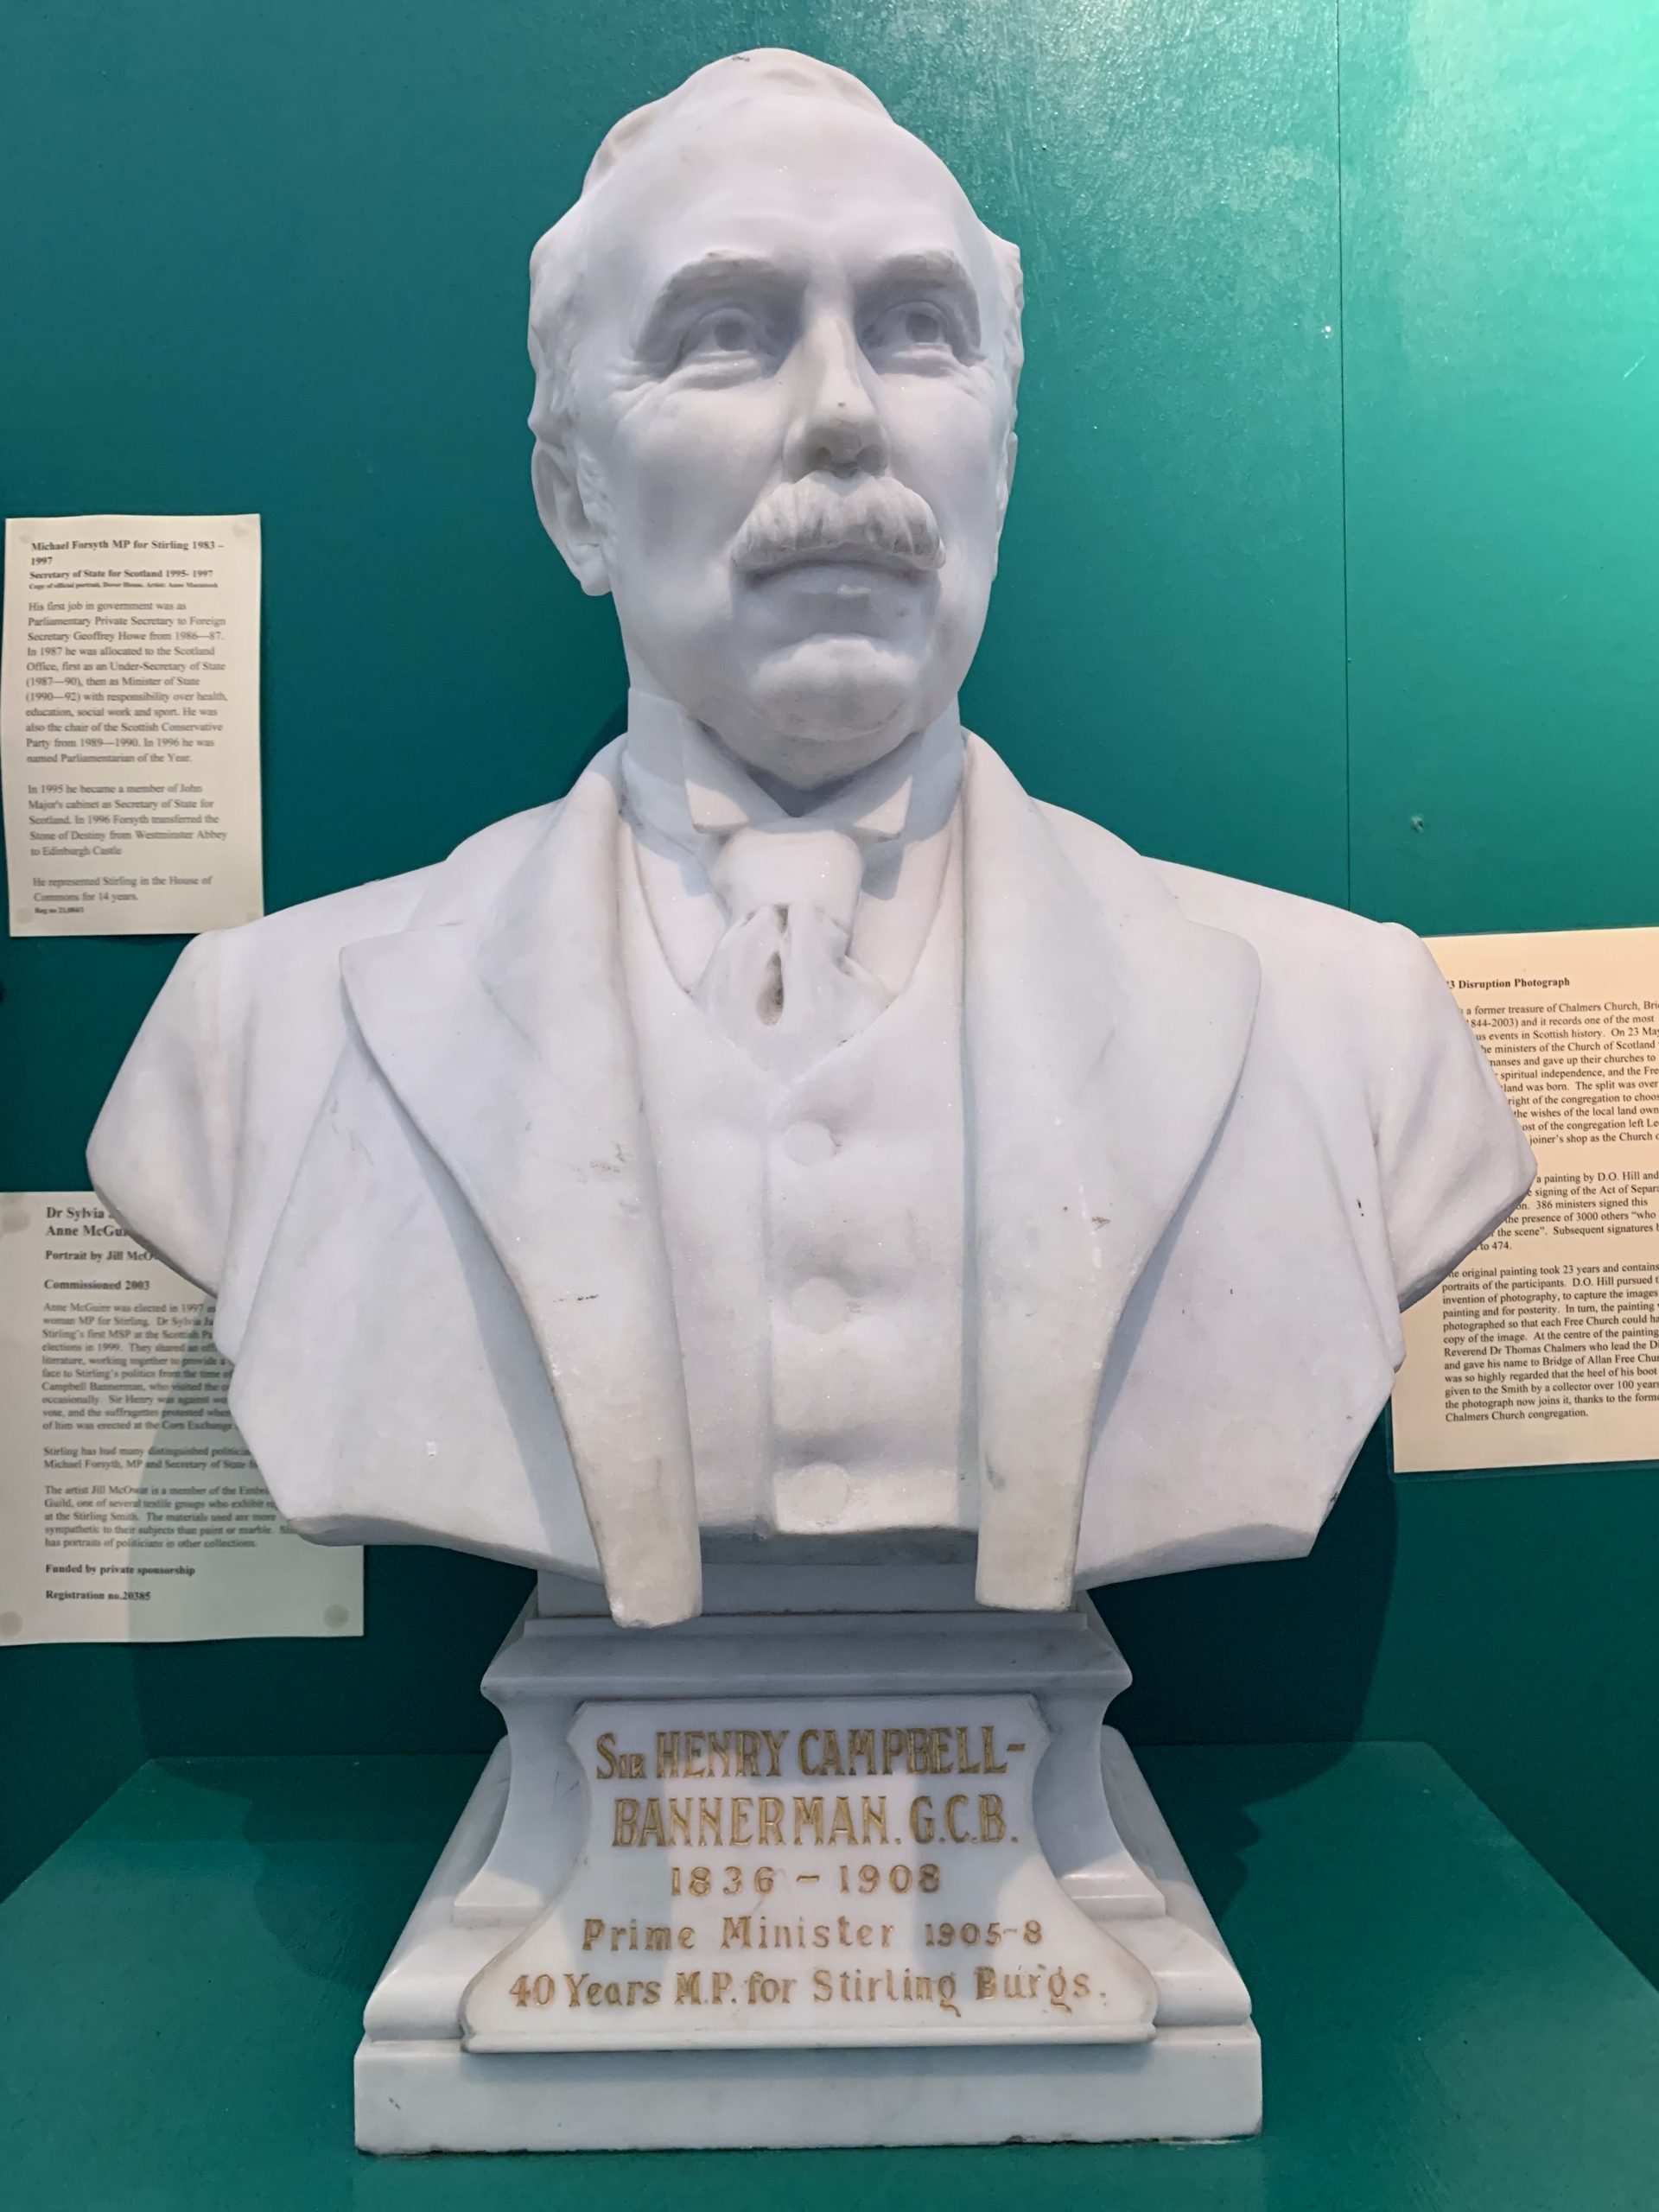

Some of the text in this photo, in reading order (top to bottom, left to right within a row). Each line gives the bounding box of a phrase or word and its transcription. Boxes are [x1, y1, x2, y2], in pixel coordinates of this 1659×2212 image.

[1459, 976, 1569, 990] Disruption Photograph
[1474, 1005, 1505, 1014] former
[1508, 1004, 1543, 1013] treasure
[1558, 1002, 1601, 1012] Chalmers
[1604, 1001, 1639, 1013] Church,
[1521, 1017, 1537, 1026] and
[1548, 1016, 1581, 1025] records
[1615, 1014, 1629, 1023] the
[1490, 1031, 1518, 1039] events
[1521, 1030, 1529, 1039] in
[1532, 1029, 1568, 1038] Scottish
[1571, 1028, 1605, 1039] history.
[1628, 1027, 1638, 1036] 23
[1536, 1200, 1553, 1209] 386
[1554, 1199, 1596, 1208] ministers
[1599, 1198, 1628, 1209] signed
[47, 1207, 104, 1220] Dr Sylvia
[46, 1227, 78, 1236] Anne
[46, 1250, 157, 1262] Portrait by Jill McO
[44, 1280, 149, 1290] Commissioned 2003
[1443, 1294, 1484, 1303] invention
[1500, 1292, 1559, 1303] photography,
[1562, 1291, 1571, 1300] to
[1573, 1290, 1606, 1301] capture
[1609, 1289, 1623, 1298] the
[1625, 1288, 1658, 1300] images
[1444, 1347, 1486, 1356] Reverend
[1506, 1344, 1541, 1354] Thomas
[1543, 1343, 1586, 1352] Chalmers
[1632, 1341, 1646, 1350] the
[1446, 1386, 1470, 1396] given
[1472, 1385, 1481, 1394] to
[1501, 1384, 1528, 1393] Smith
[1530, 1383, 1541, 1394] by
[1552, 1382, 1591, 1391] collector
[1461, 1398, 1513, 1409] photograph
[1538, 1396, 1560, 1407] joins
[1562, 1395, 1571, 1406] it,
[1573, 1395, 1603, 1403] thanks
[1446, 1408, 1588, 1421] Chalmers Church congregation.
[46, 1564, 194, 1576] Funded by private sponsorship
[46, 1590, 105, 1601] Registration
[656, 1729, 790, 1778] HENRY
[798, 1725, 1026, 1776] CAMPBELL-
[612, 1794, 1019, 1847] BANNERMAN. G.C.B.
[671, 1866, 774, 1897] 1836
[841, 1862, 941, 1895] 1908
[582, 1915, 1043, 1951] Prime Minister 1905-8
[510, 1974, 555, 2007] 40
[563, 1973, 662, 2007] Years
[674, 1970, 737, 2005] M.P.
[745, 1970, 798, 2005] for
[812, 1967, 962, 2018] Stirling
